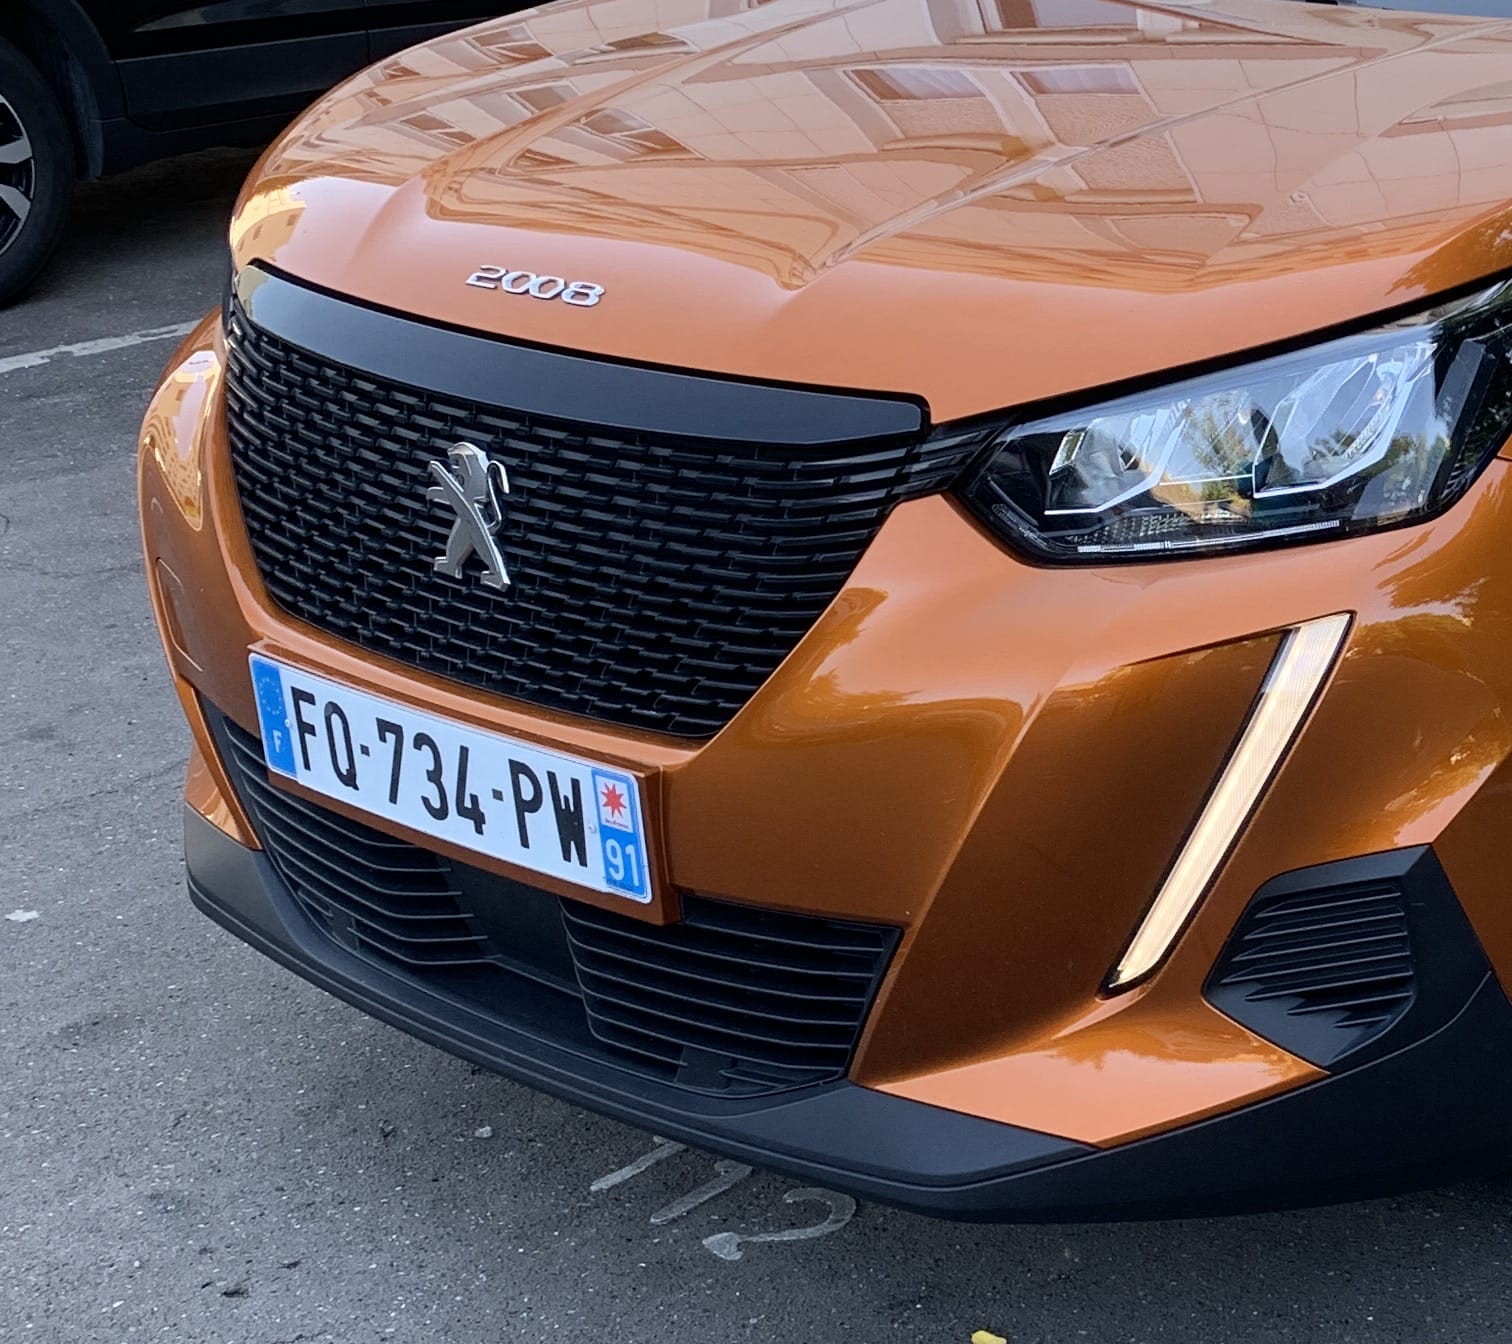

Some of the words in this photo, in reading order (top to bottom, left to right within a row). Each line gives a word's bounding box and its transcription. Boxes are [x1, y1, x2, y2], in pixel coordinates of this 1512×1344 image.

[465, 264, 606, 307] 2008
[272, 730, 283, 754] F
[290, 686, 588, 868] FQ-734-PW
[605, 838, 641, 887] 91
